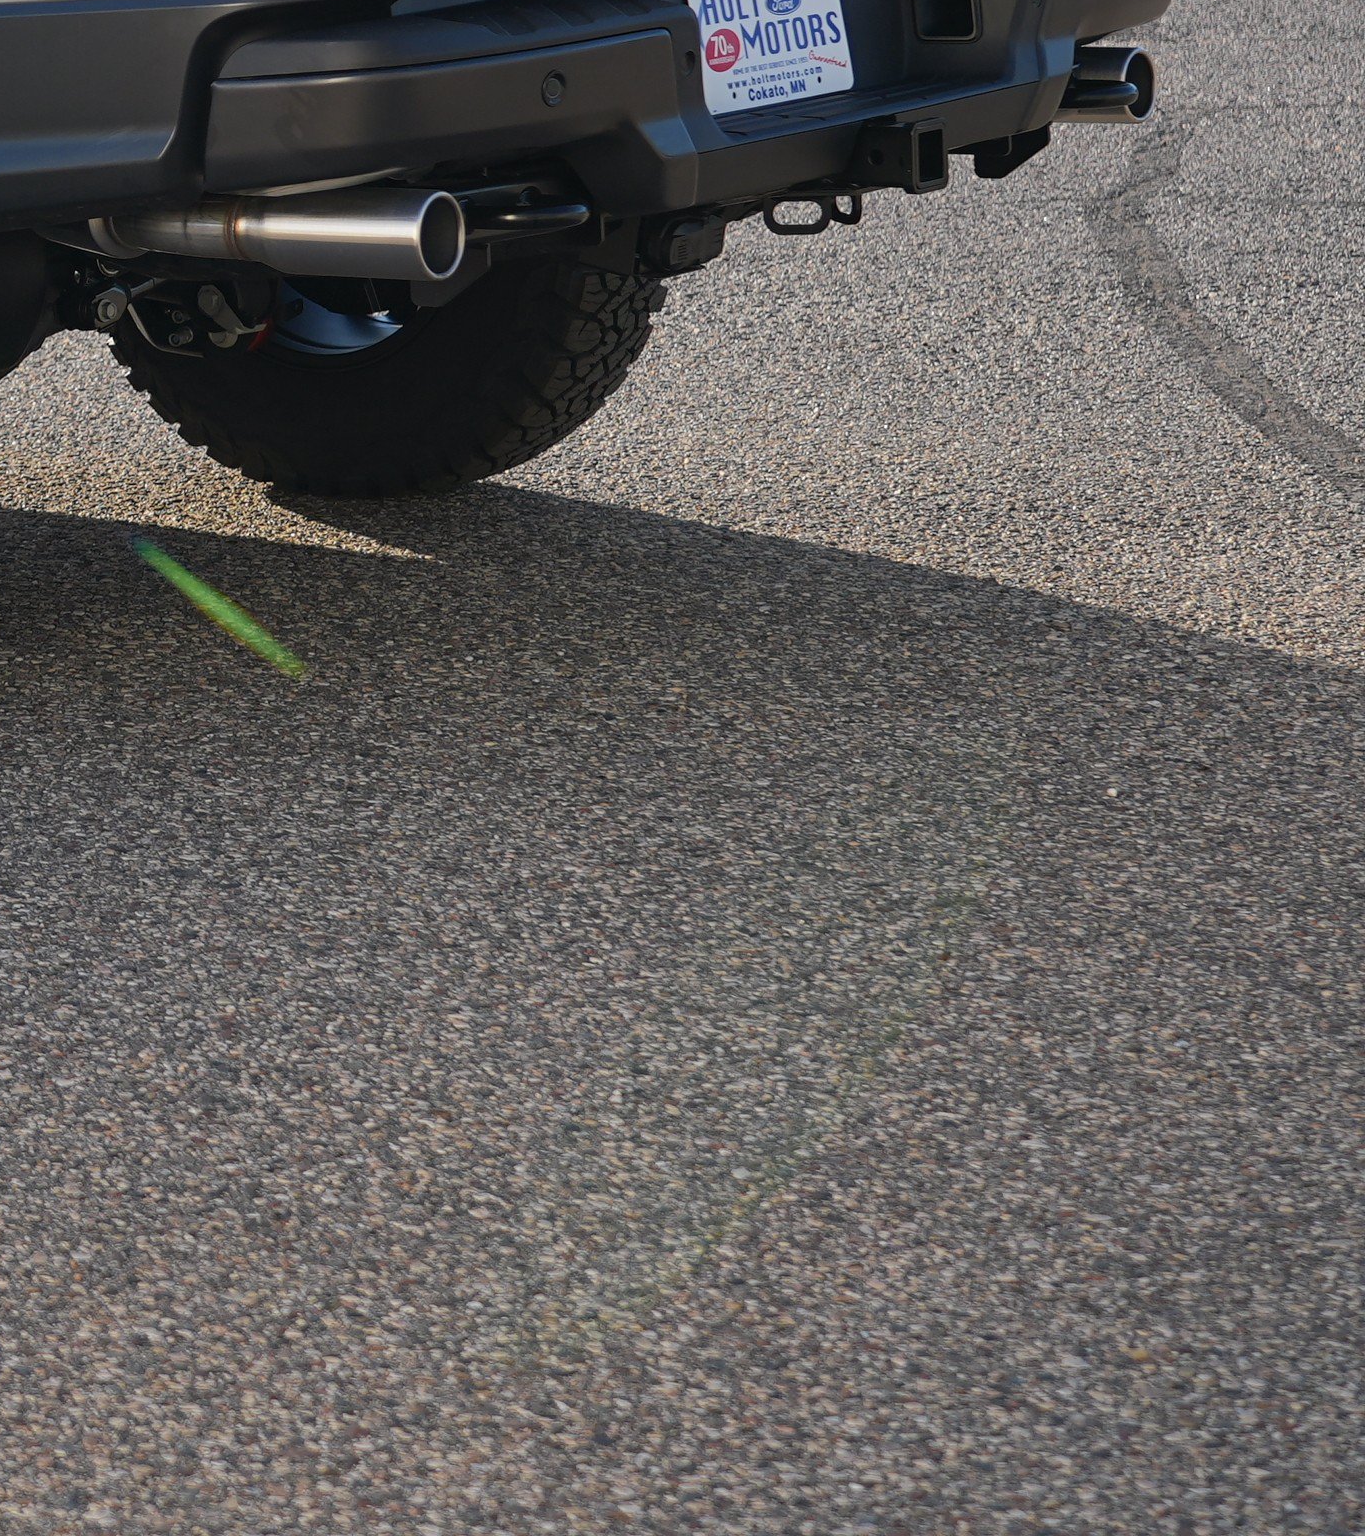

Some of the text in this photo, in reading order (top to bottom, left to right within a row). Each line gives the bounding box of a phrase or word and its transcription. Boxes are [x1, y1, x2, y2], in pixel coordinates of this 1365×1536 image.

[739, 11, 842, 60] MOTORS
[727, 66, 823, 89] www.holtmotors.com
[748, 79, 807, 101] Cokato, MN
